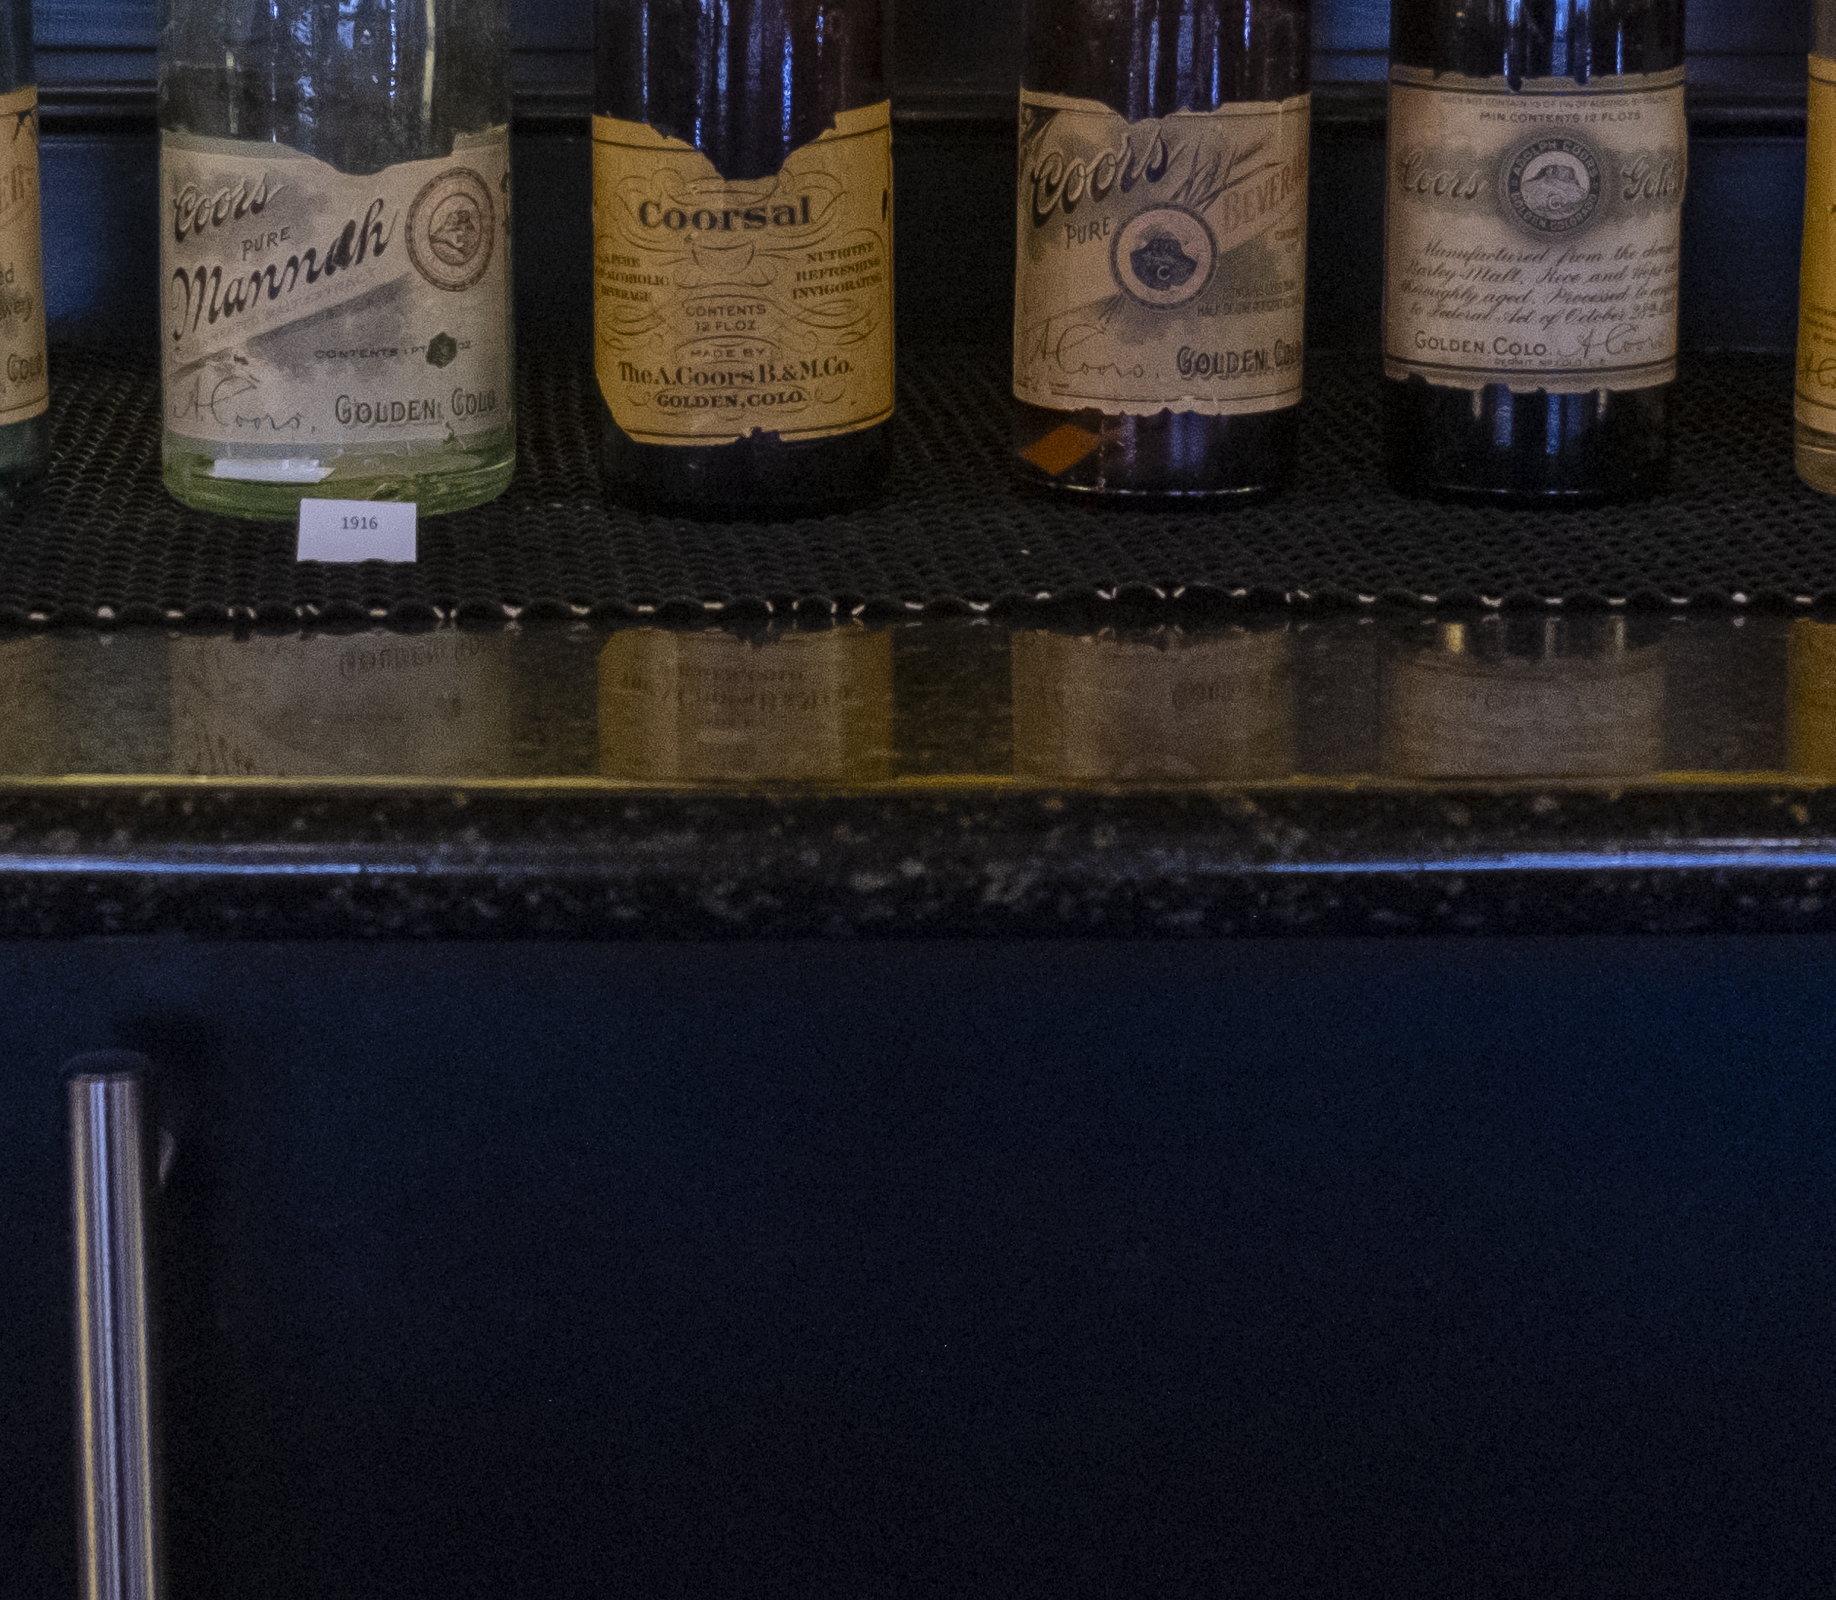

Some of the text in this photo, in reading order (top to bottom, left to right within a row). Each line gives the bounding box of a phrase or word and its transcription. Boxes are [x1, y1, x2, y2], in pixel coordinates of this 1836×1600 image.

[1509, 112, 1581, 124] CONTENTS
[1031, 125, 1175, 229] Coors
[172, 173, 277, 244] Coors
[637, 194, 813, 232] Coorsal
[241, 225, 292, 262] PURE
[1064, 215, 1111, 250] PURE
[170, 197, 401, 343] Mannah
[685, 303, 767, 318] CONTENTS
[694, 320, 711, 333] 12
[314, 347, 399, 360] CONTENTS
[690, 346, 766, 358] MADE BY
[617, 360, 653, 385] The
[341, 515, 378, 531] 1916
